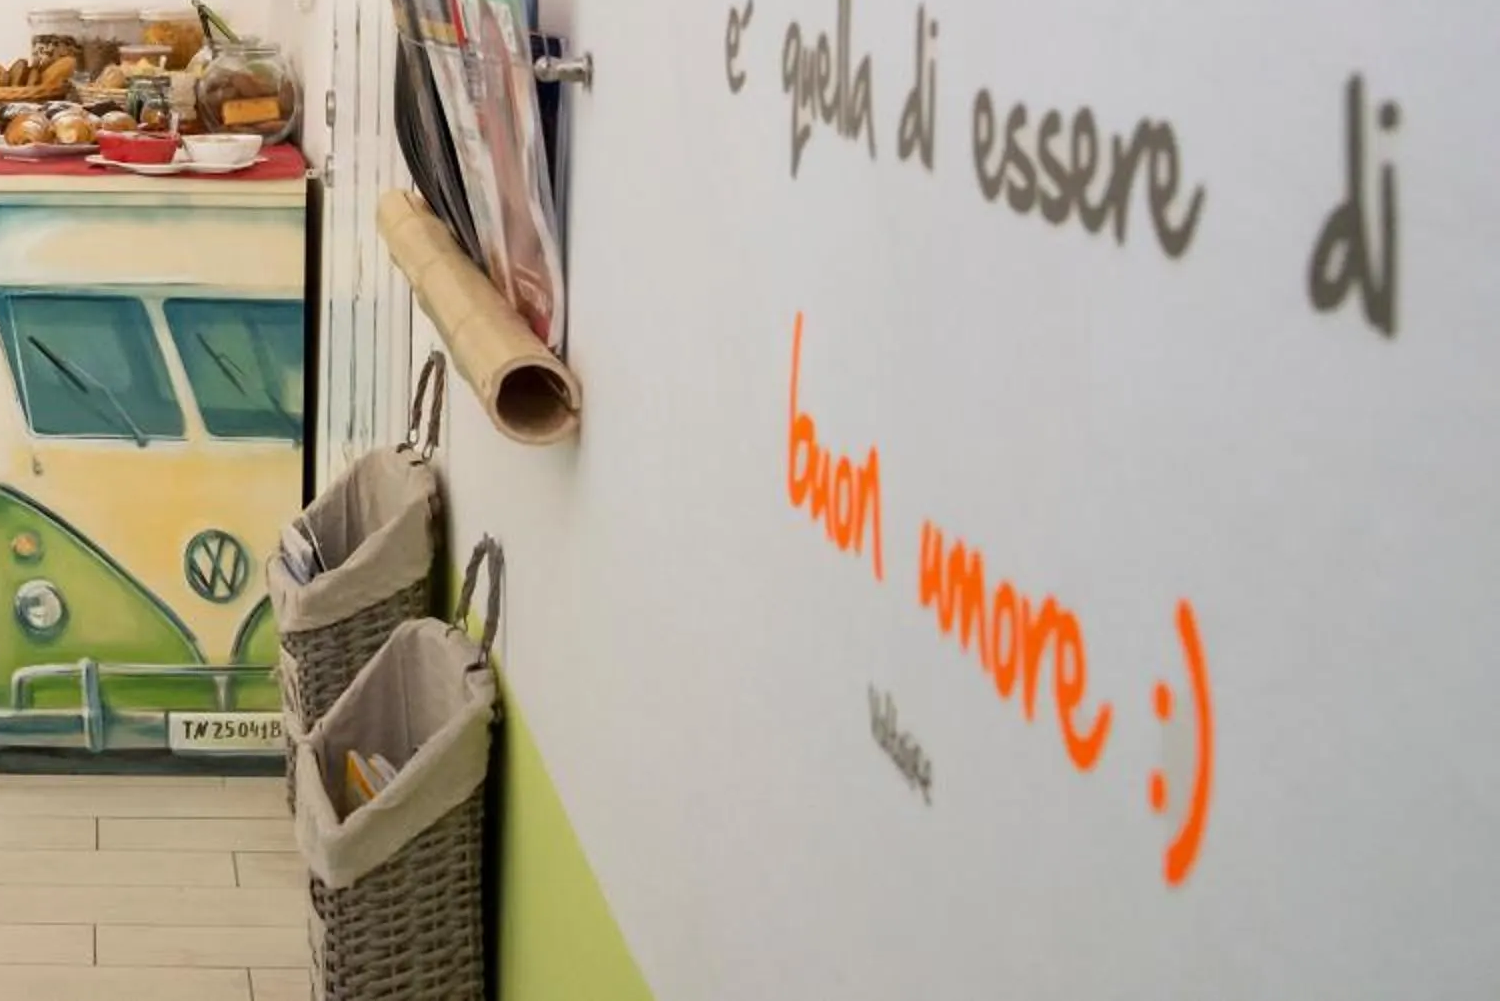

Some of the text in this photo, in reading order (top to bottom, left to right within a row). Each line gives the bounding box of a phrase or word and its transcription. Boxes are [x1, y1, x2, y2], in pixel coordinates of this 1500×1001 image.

[899, 3, 938, 173] di
[971, 87, 1206, 260] essere
[1307, 71, 1402, 339] di
[787, 310, 883, 582] buon
[920, 519, 1112, 772] umore
